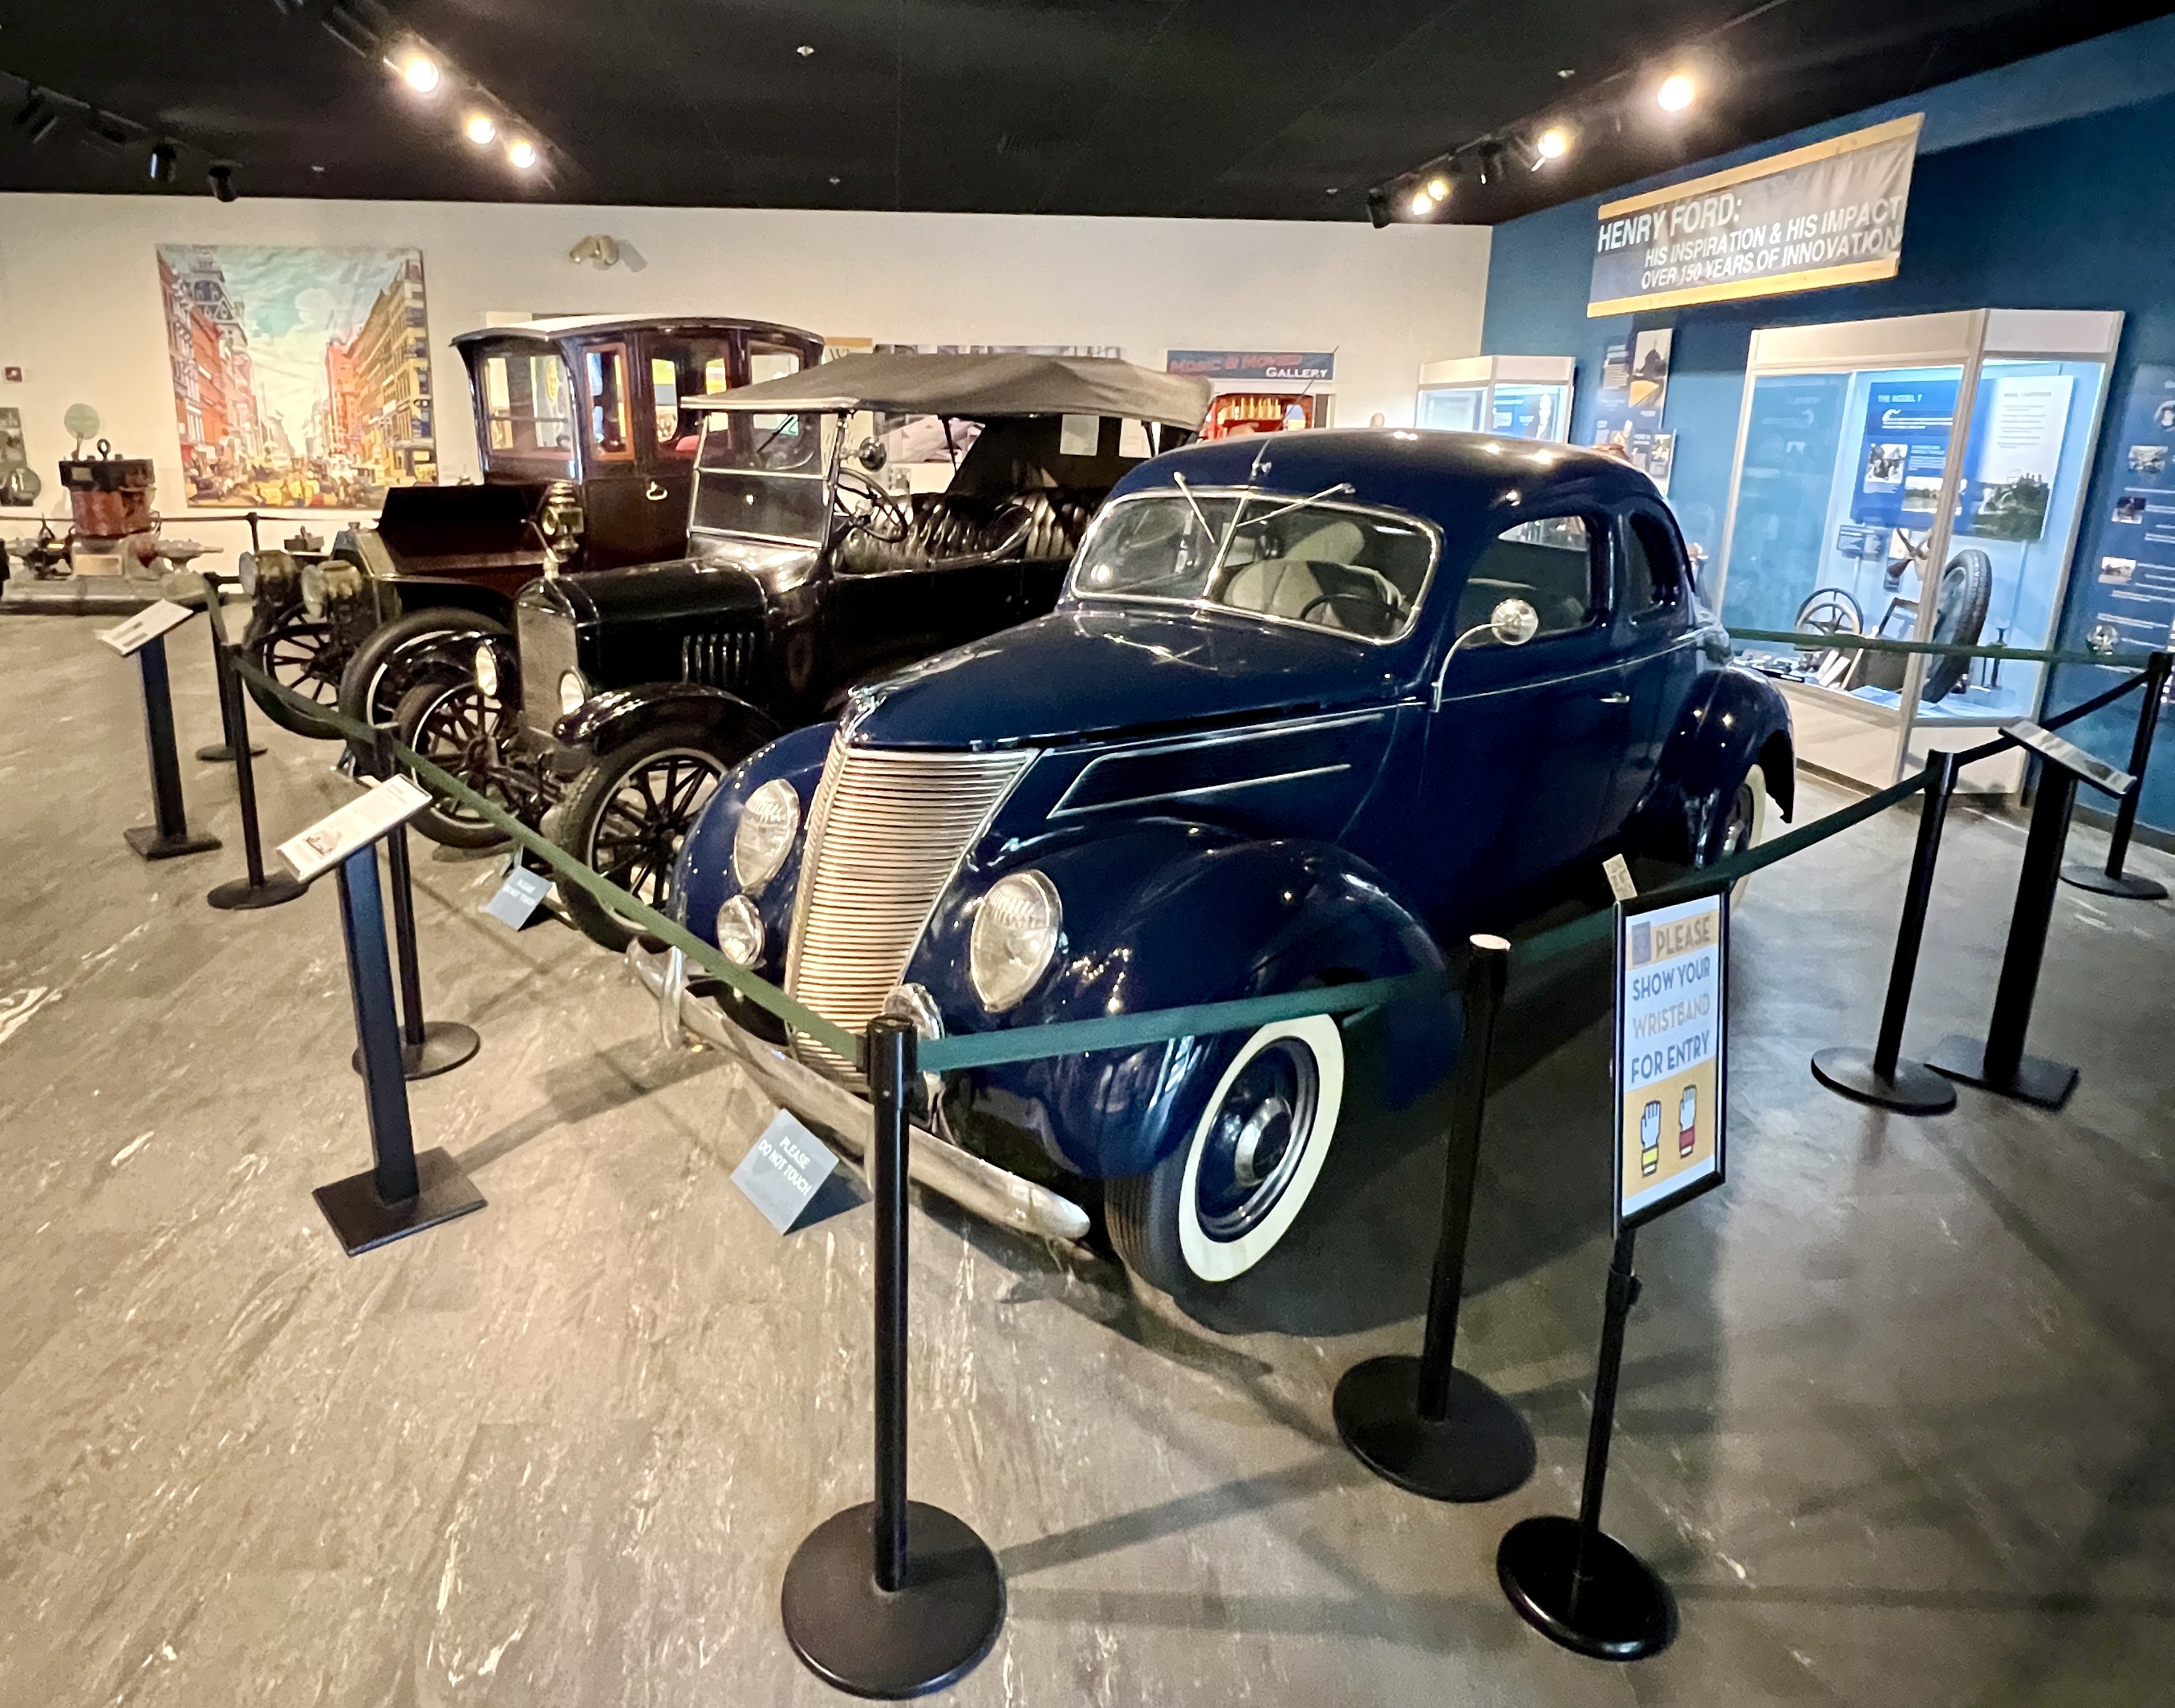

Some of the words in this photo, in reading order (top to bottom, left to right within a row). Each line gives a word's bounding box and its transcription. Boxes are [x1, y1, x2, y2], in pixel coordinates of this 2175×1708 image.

[1597, 209, 1667, 252] HENRY
[1670, 193, 1742, 237] FORD:
[1645, 245, 1668, 268] HIS
[1670, 224, 1767, 264] INSPIRATION
[1769, 222, 1782, 245] &
[1786, 214, 1818, 241] HIS
[1821, 196, 1902, 235] IMPACT
[1641, 266, 1678, 290] OVER
[1678, 262, 1702, 284] 150
[1706, 253, 1754, 278] YEARS
[1756, 247, 1779, 271] OF
[1781, 225, 1902, 267] INNOVATION
[1265, 367, 1329, 379] GALLERY
[1656, 916, 1711, 957] PLEASE
[1633, 968, 1674, 1001] SHOW
[1677, 955, 1710, 988] YOUR
[1633, 992, 1710, 1039] WRISTBAND
[1631, 1050, 1662, 1083] FOR
[1667, 1029, 1710, 1070] ENTRY
[758, 1138, 772, 1156] DO
[769, 1150, 788, 1170] NOT
[783, 1164, 812, 1196] TOUCH
[779, 1136, 810, 1170] PLEASE
